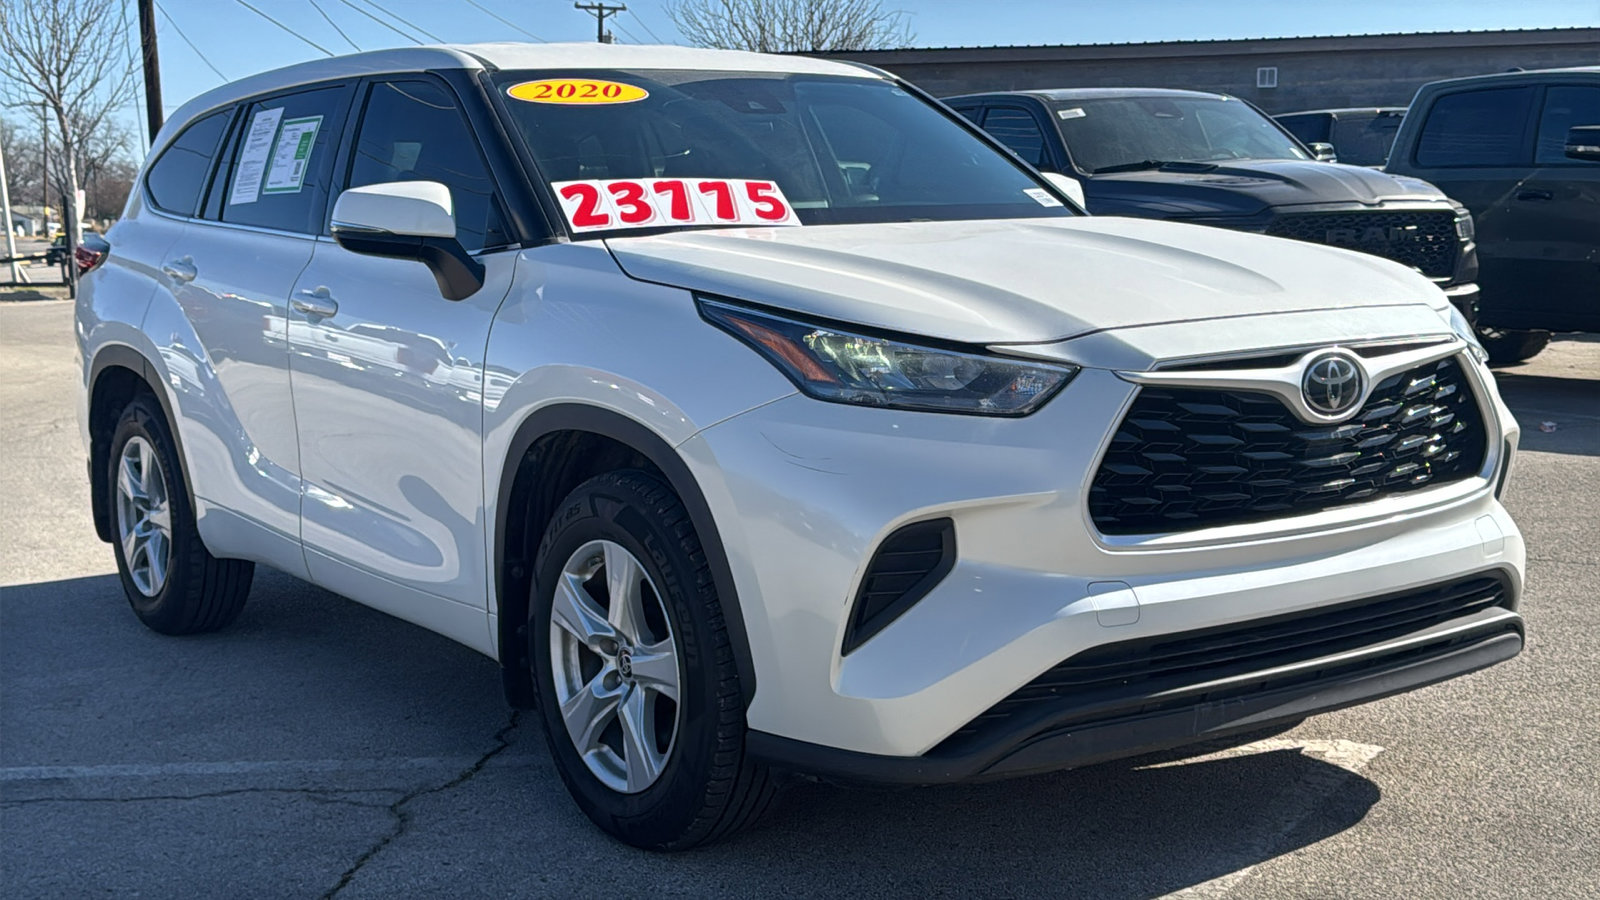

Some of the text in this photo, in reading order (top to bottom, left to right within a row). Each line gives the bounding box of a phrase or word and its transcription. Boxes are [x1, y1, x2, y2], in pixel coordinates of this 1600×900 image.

[533, 83, 622, 99] 2020
[560, 180, 789, 229] 23775
[1326, 226, 1417, 244] RAM
